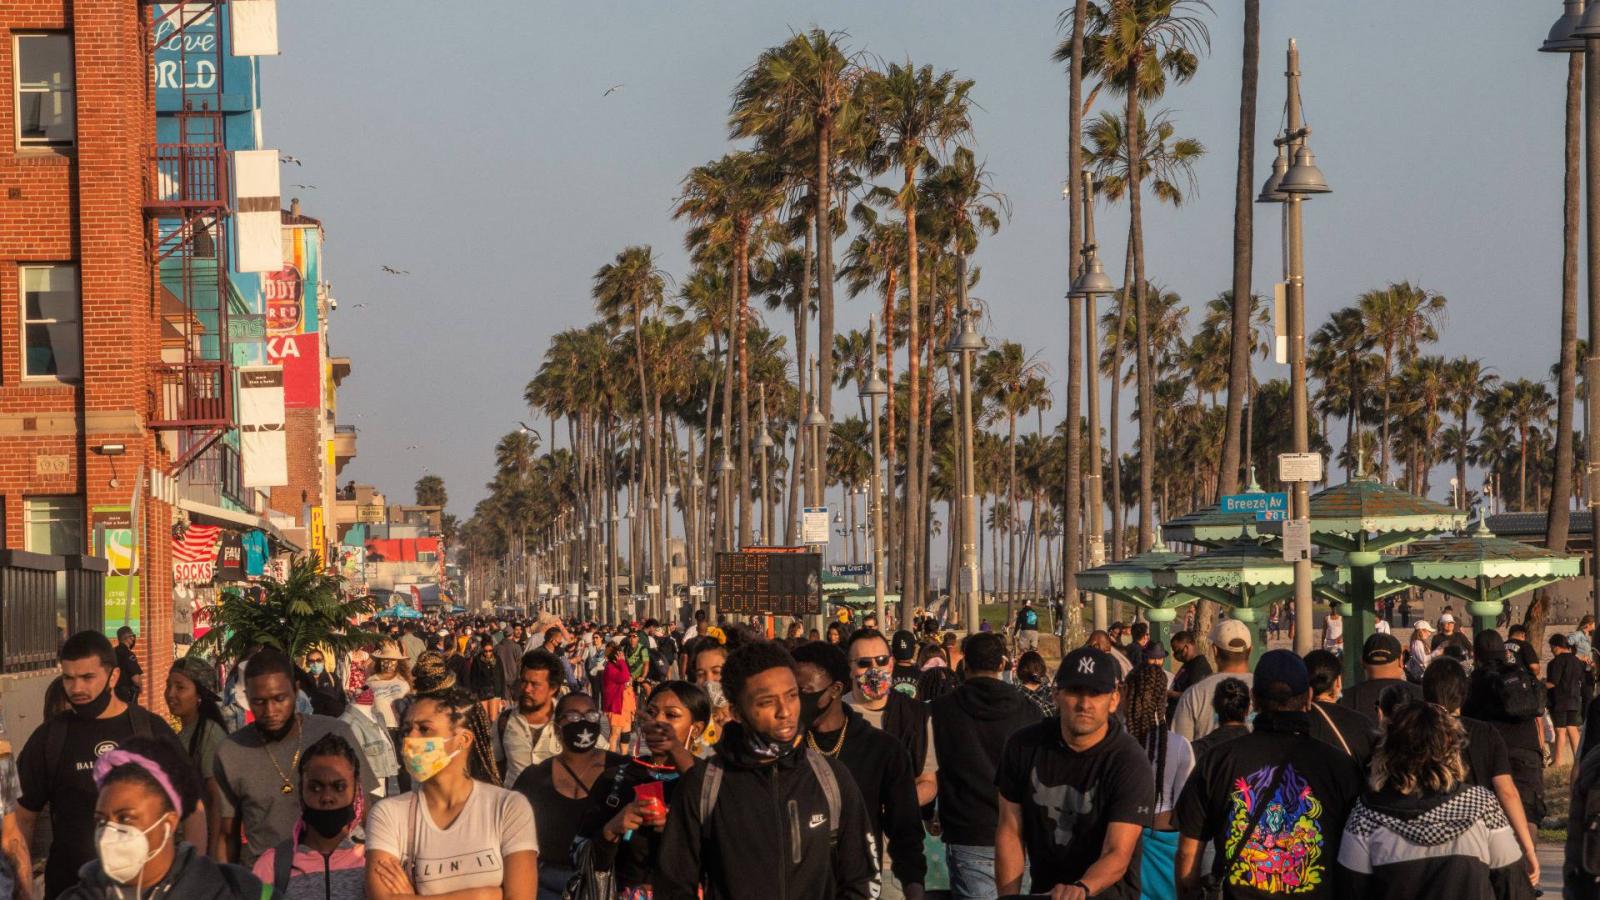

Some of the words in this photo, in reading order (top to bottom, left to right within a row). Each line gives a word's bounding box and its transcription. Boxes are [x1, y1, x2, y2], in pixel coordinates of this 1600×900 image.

[269, 307, 296, 317] RED
[1227, 498, 1266, 510] Breeze
[1270, 497, 1282, 507] Av
[175, 563, 211, 580] SOCKS
[847, 564, 864, 572] Crest
[720, 574, 769, 592] FACE
[720, 594, 819, 612] COVERING
[1077, 656, 1096, 673] NY
[477, 854, 494, 867] IT
